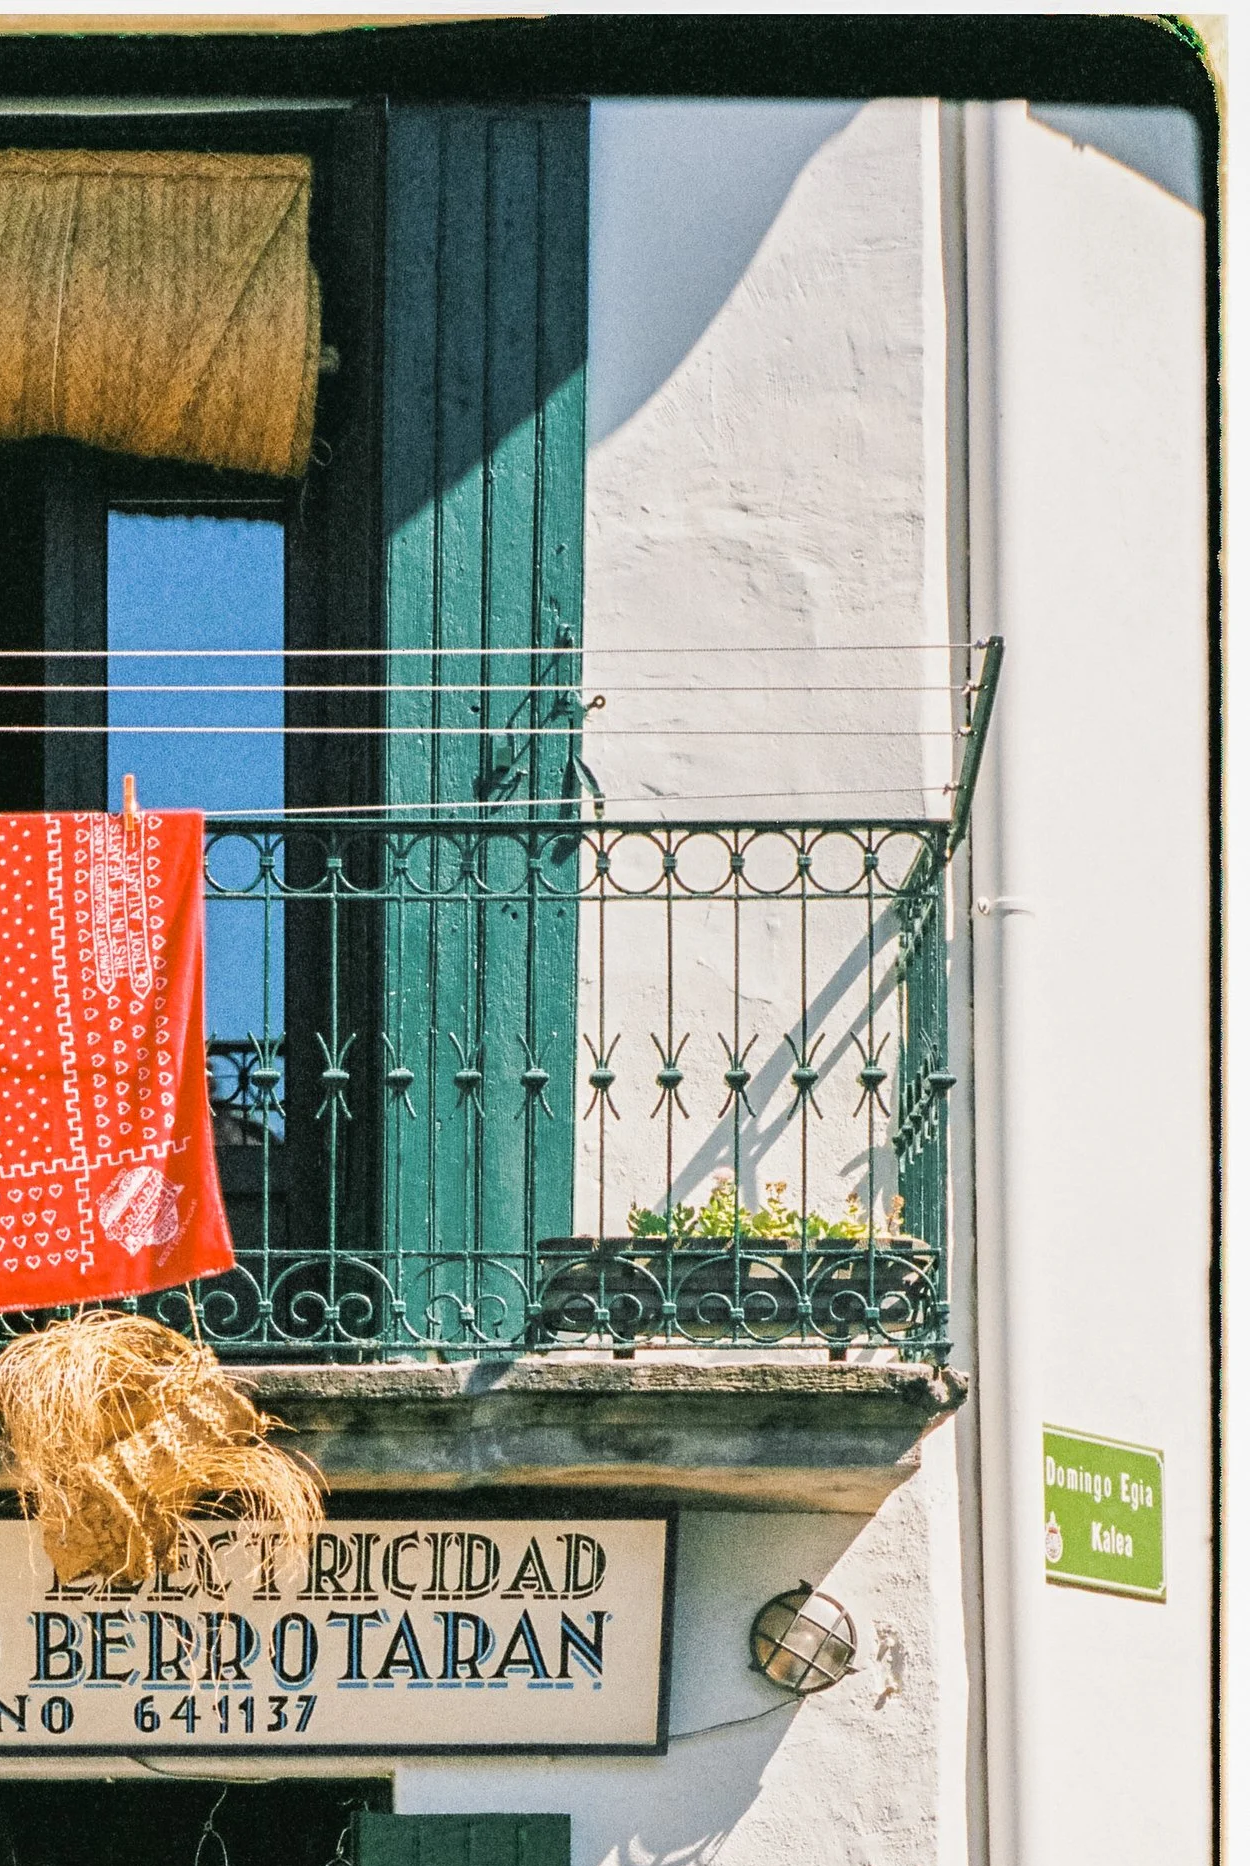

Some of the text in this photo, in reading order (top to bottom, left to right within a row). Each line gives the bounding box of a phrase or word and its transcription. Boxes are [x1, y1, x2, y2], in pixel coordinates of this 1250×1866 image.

[109, 885, 124, 915] THE
[111, 917, 125, 933] IN
[112, 936, 129, 978] FIRST
[130, 930, 149, 988] DETROIT
[1045, 1455, 1154, 1512] Domingo Egia
[1091, 1520, 1134, 1559] Kalea
[26, 1609, 614, 1690] BERROTARAN
[134, 1694, 318, 1735] 641137
